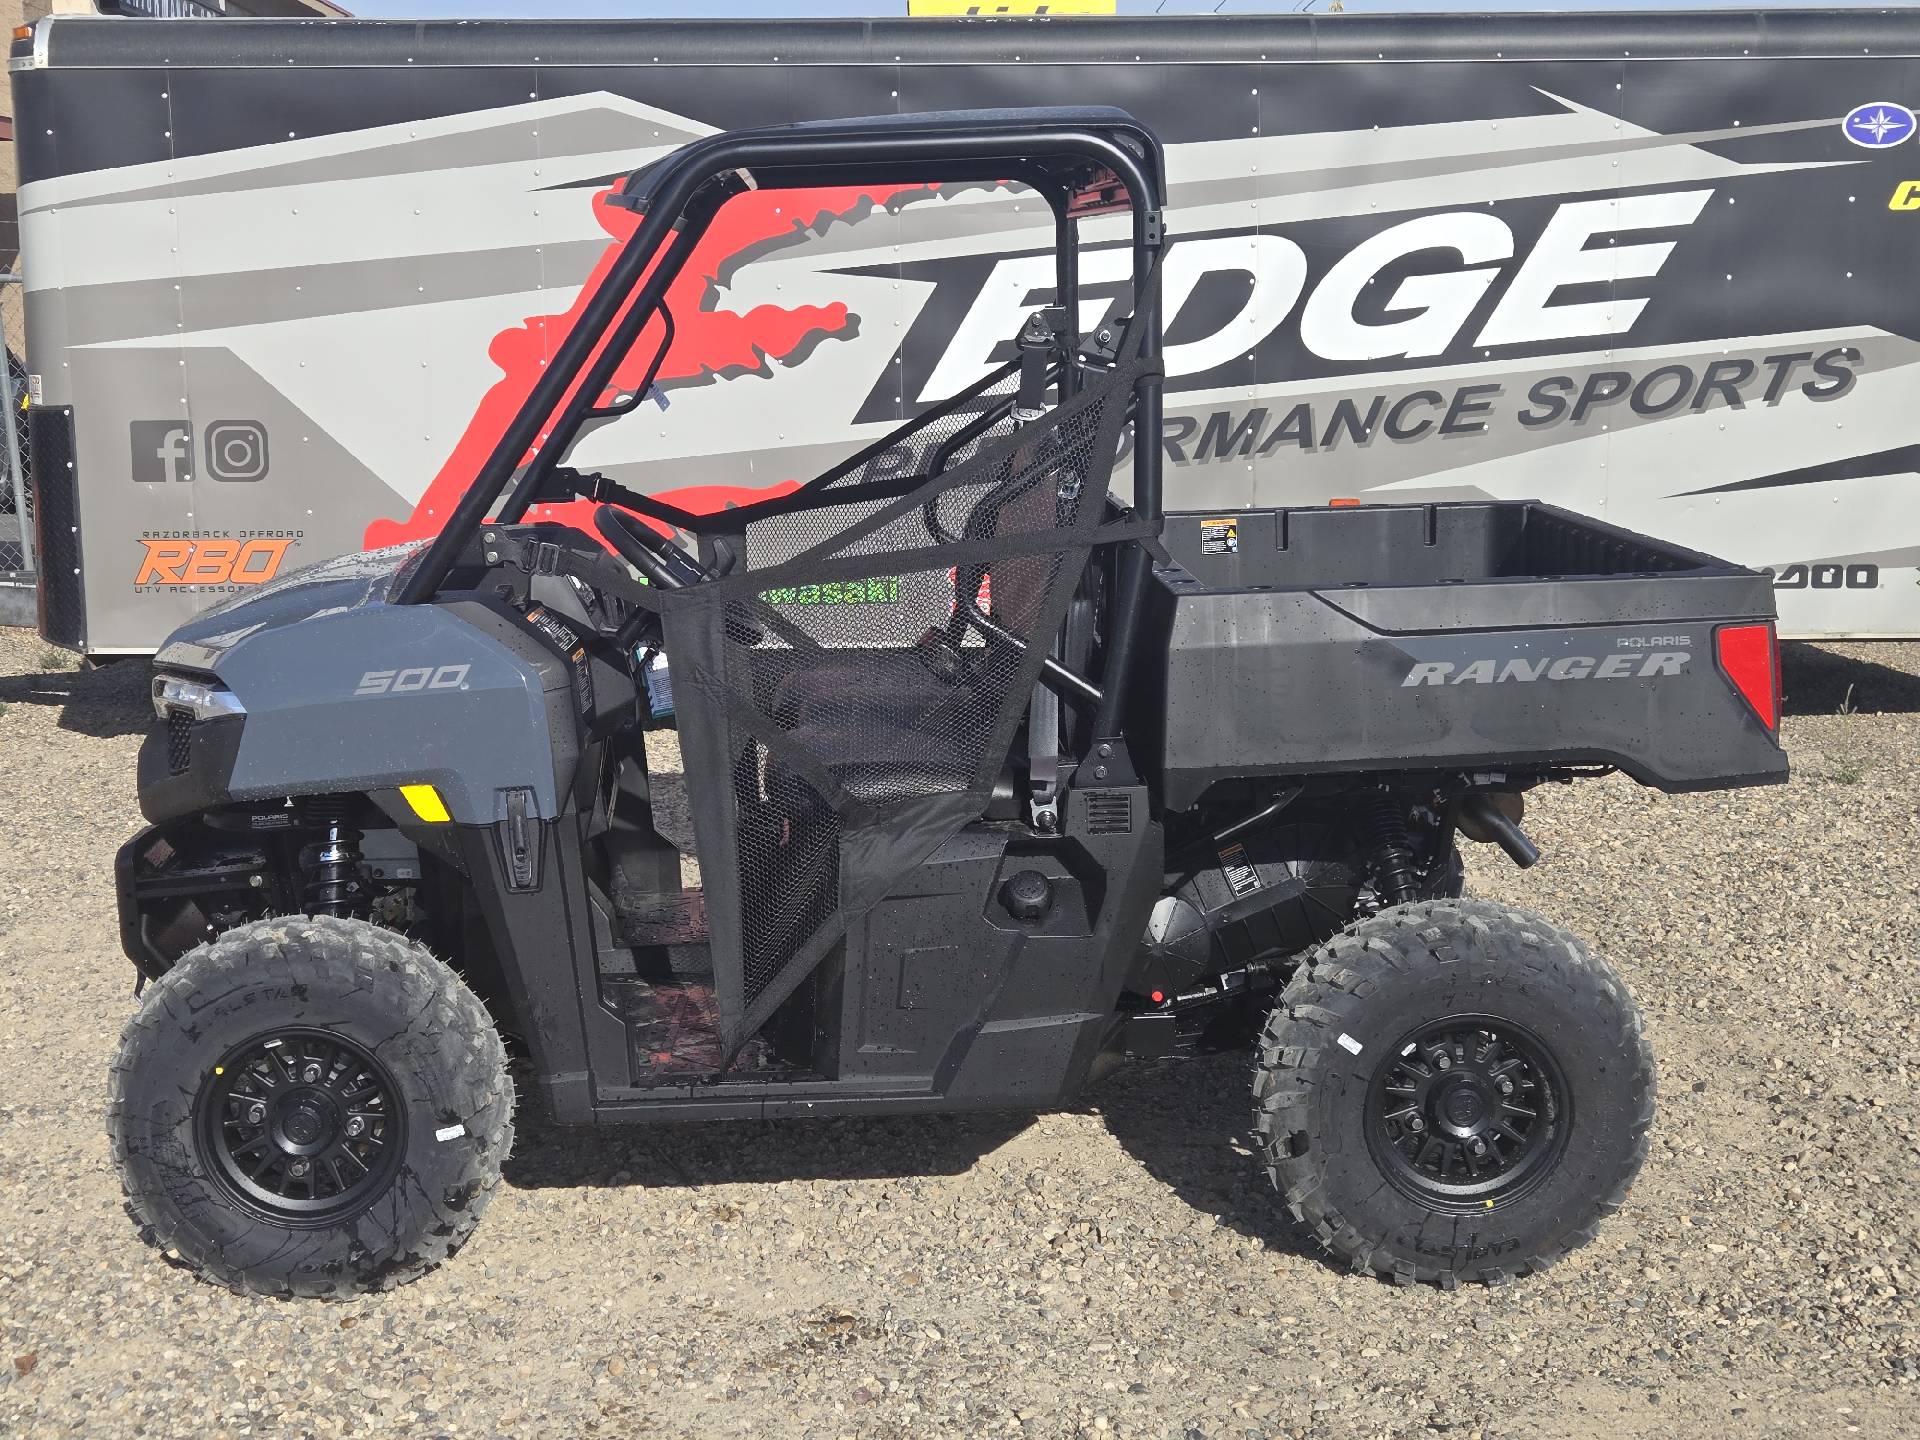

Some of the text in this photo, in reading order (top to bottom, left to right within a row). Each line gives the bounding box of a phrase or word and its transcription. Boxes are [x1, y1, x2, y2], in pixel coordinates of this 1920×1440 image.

[916, 188, 1715, 402] EDGE
[1517, 347, 1864, 427] SPORTS
[142, 530, 304, 539] RAZORBACK OFFROAD
[134, 539, 297, 585] RBO
[134, 585, 161, 593] UTV
[1616, 635, 1691, 648] POLARIS
[353, 663, 472, 696] 500
[1400, 651, 1692, 688] RANGER
